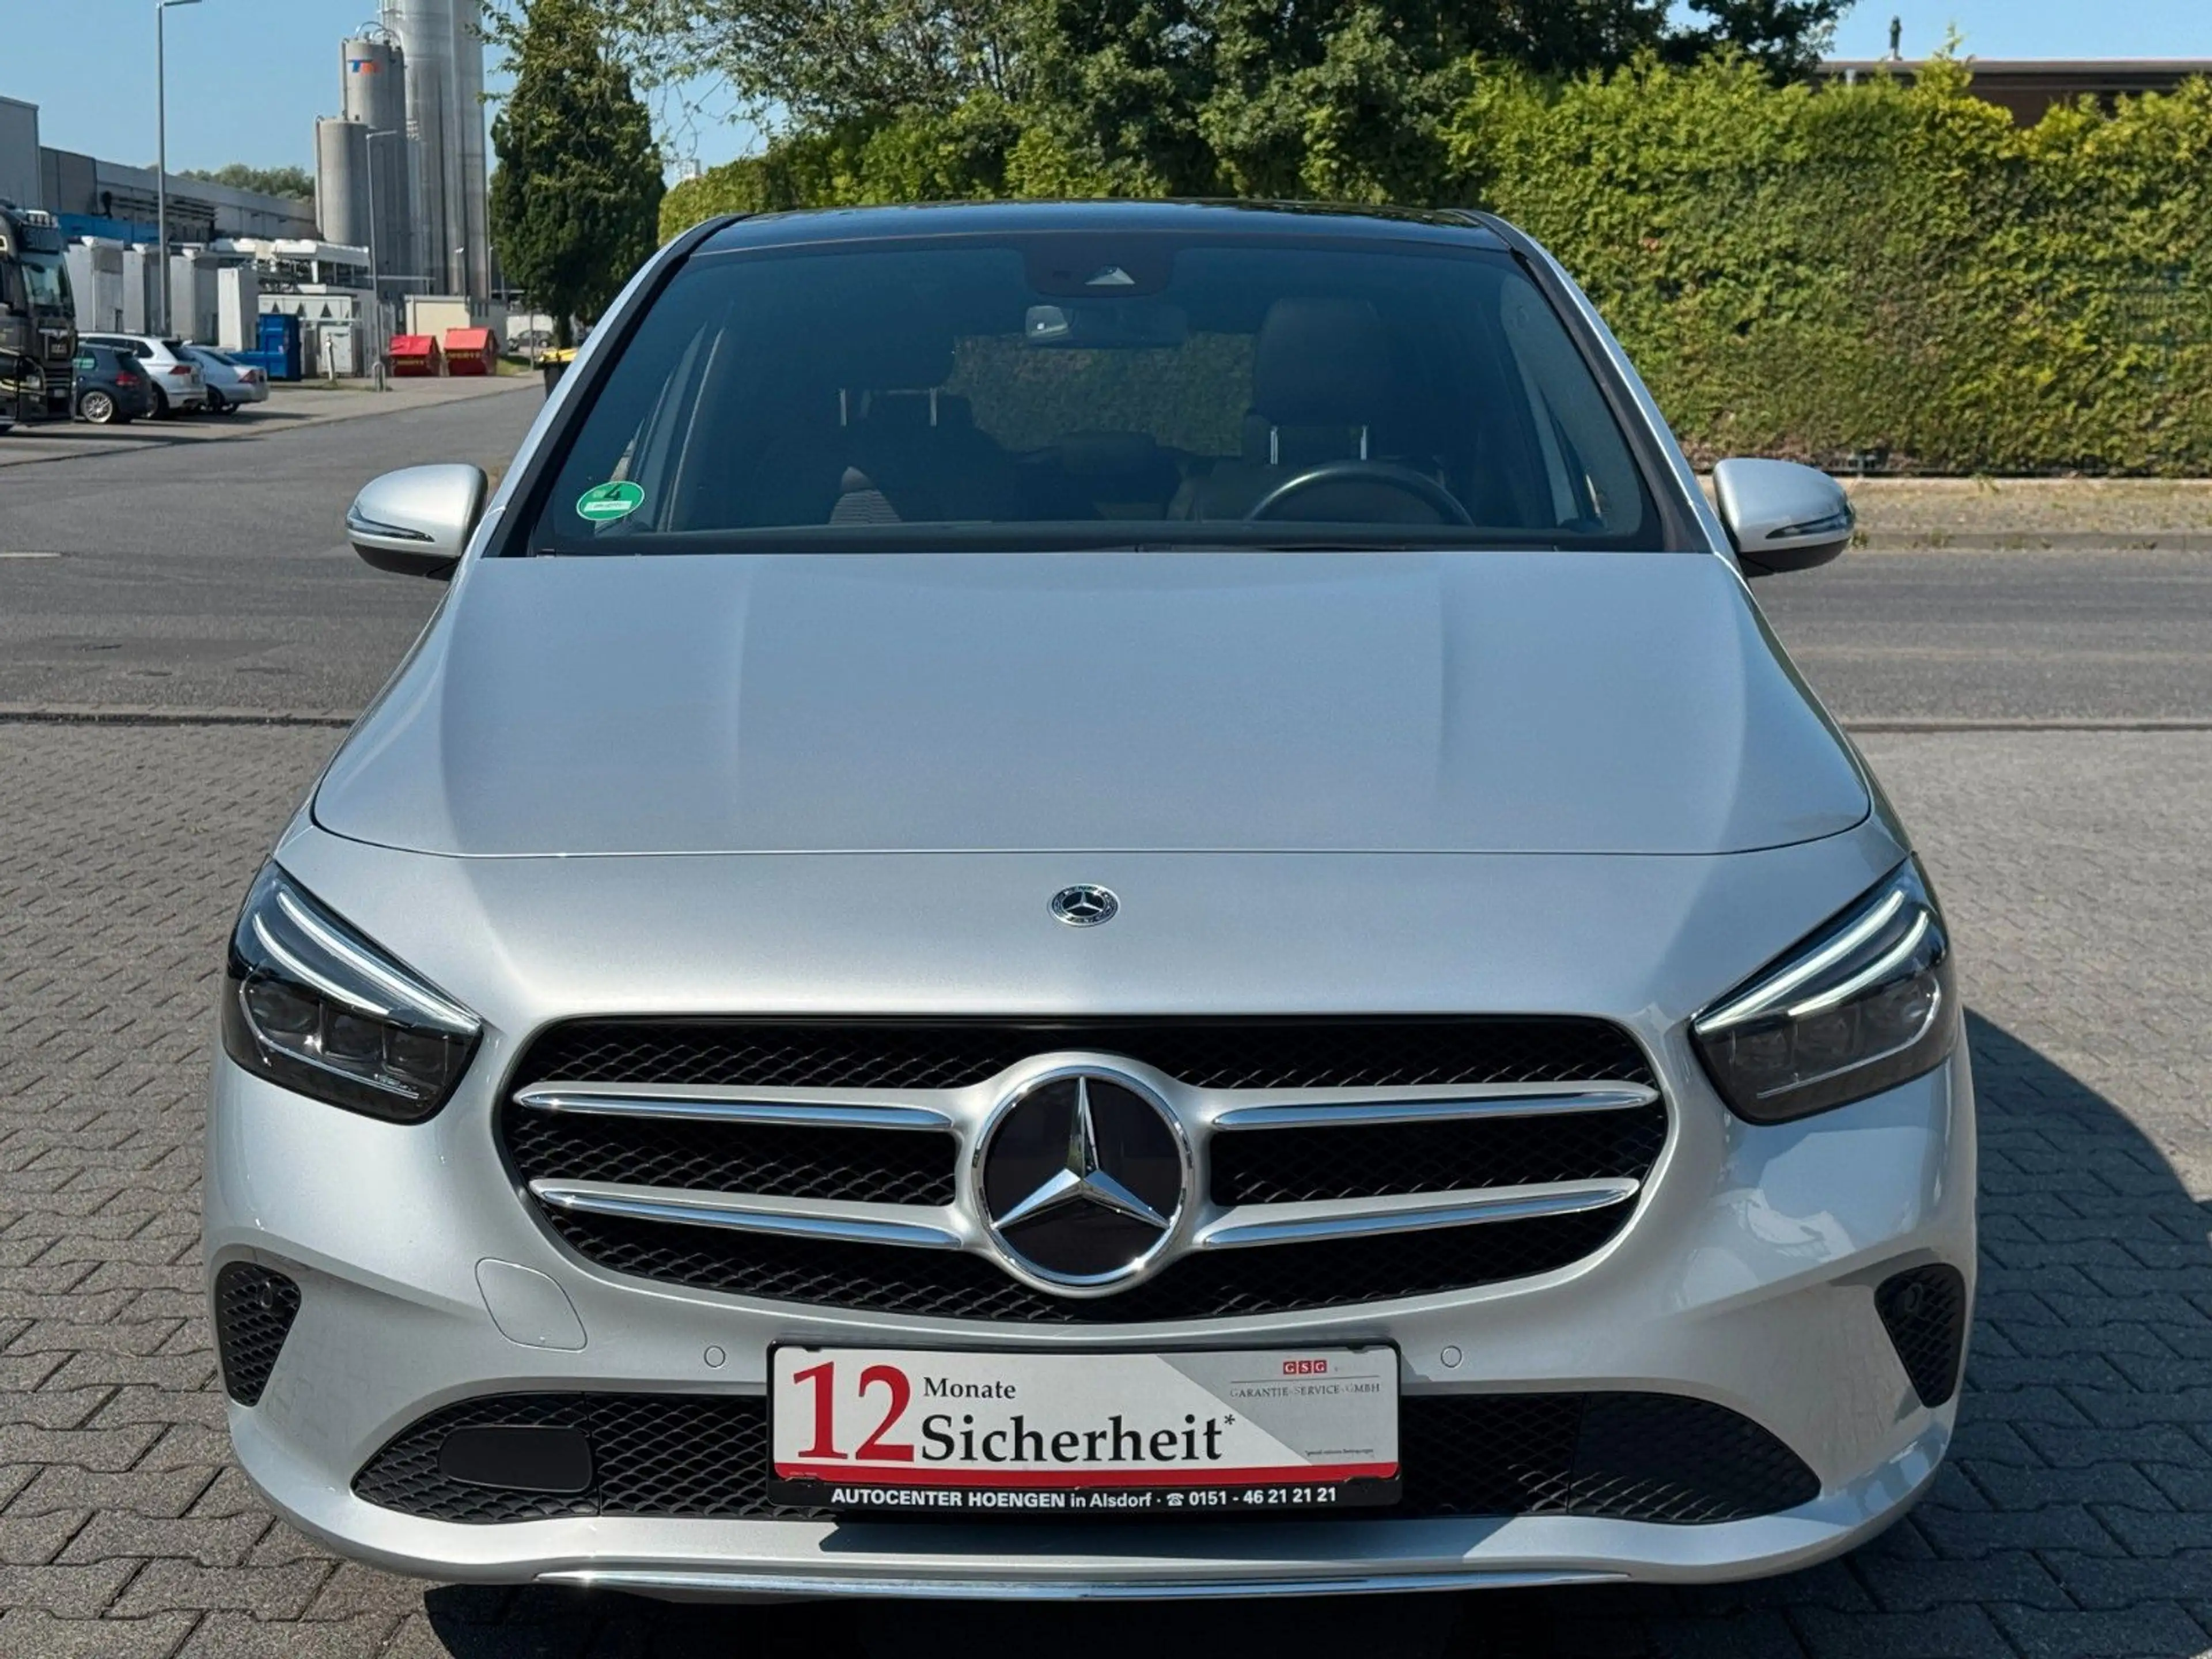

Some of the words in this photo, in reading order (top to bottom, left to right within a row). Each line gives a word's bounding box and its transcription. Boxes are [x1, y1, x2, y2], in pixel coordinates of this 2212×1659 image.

[604, 483, 622, 501] 4
[1284, 1361, 1327, 1374] GSG
[924, 1377, 1016, 1399] Monate
[794, 1361, 915, 1462] 12
[831, 1488, 962, 1507] AUTOCENTER
[969, 1492, 1065, 1508] HOENGEN
[1070, 1493, 1086, 1507] in
[1089, 1493, 1152, 1508] Alsdorf
[1188, 1491, 1226, 1505] 0151
[1243, 1490, 1263, 1504] 46
[1267, 1490, 1286, 1503] 21
[1292, 1488, 1311, 1502] 21
[1317, 1487, 1336, 1501] 21
